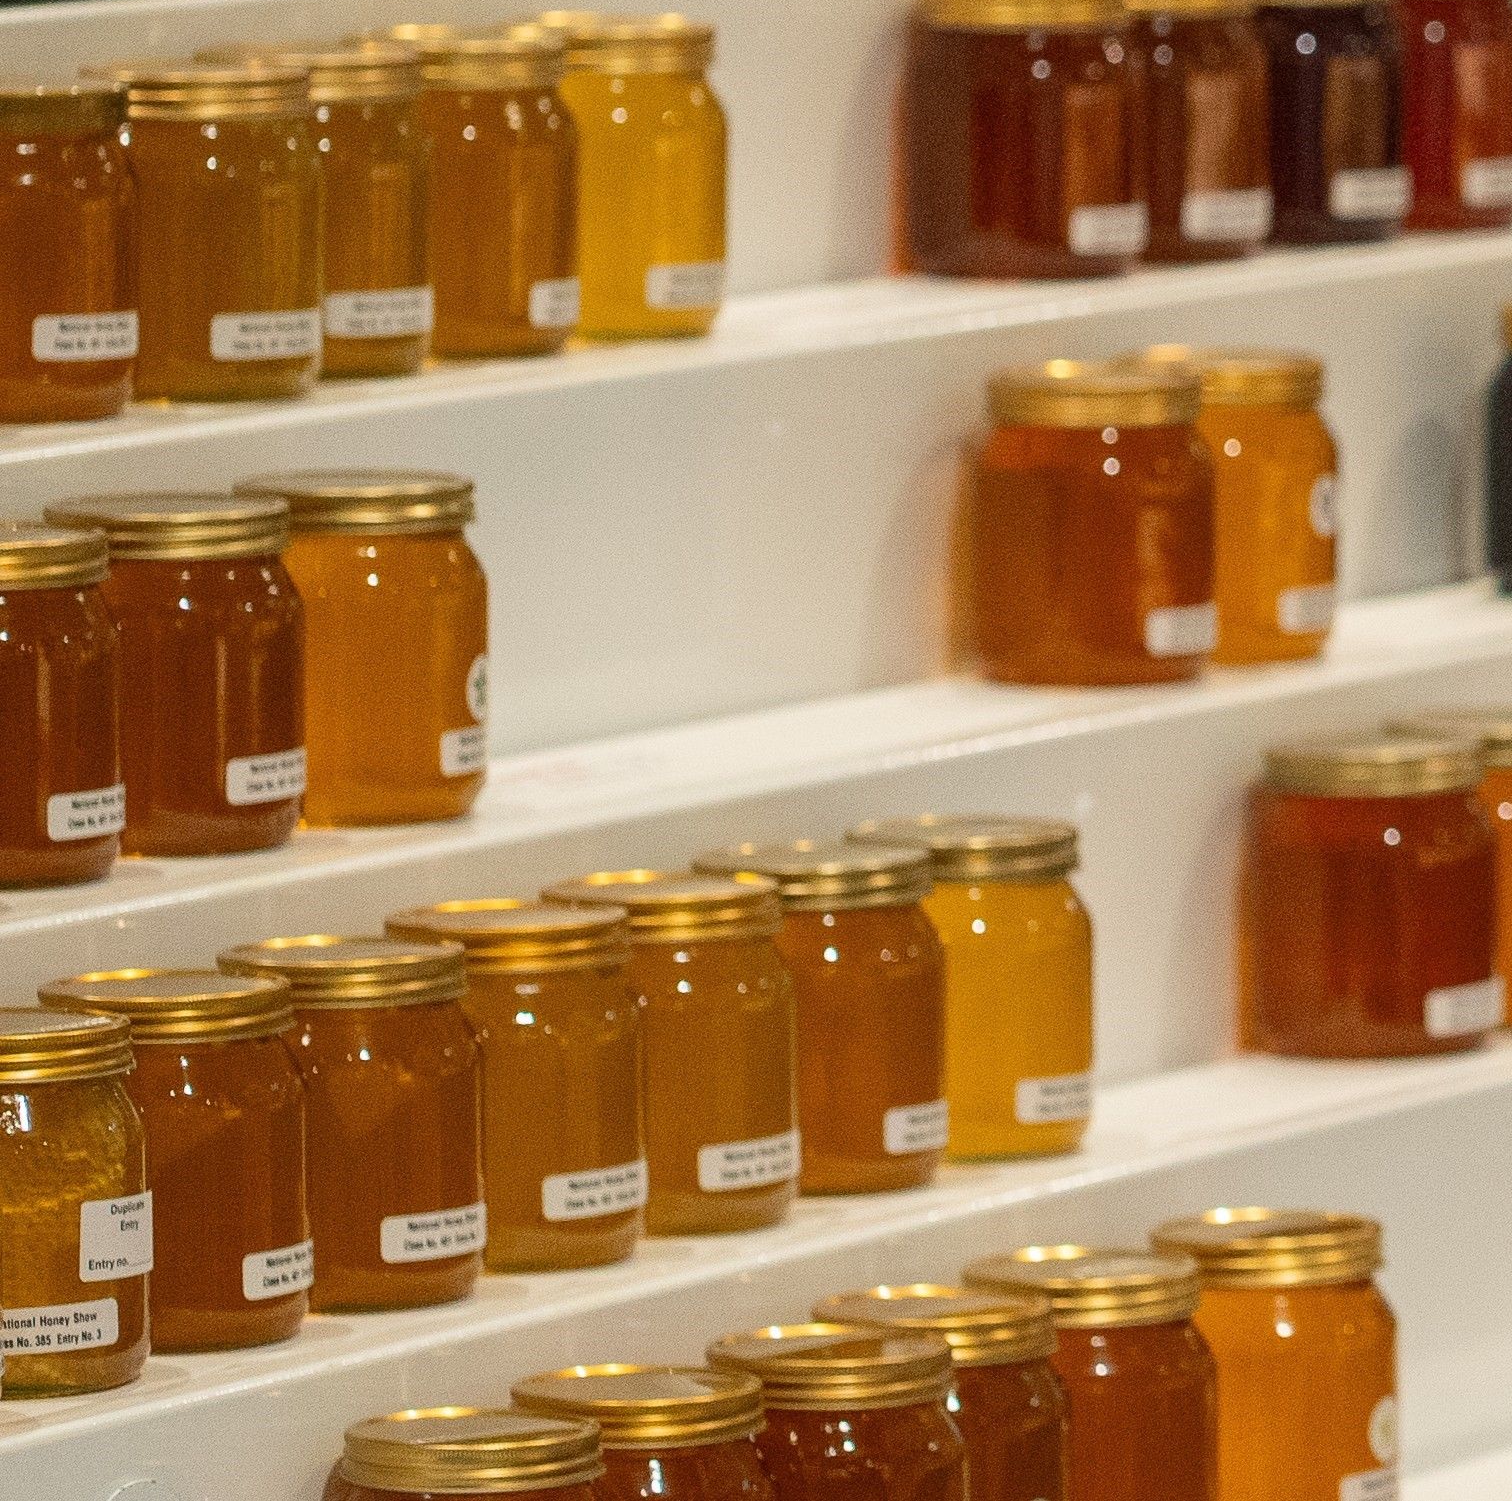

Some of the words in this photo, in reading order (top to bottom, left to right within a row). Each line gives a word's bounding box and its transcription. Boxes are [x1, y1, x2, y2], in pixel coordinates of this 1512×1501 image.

[88, 1258, 115, 1271] Entry
[40, 1314, 71, 1328] Honey
[73, 1311, 98, 1323] Show
[57, 1332, 80, 1345] Entry
